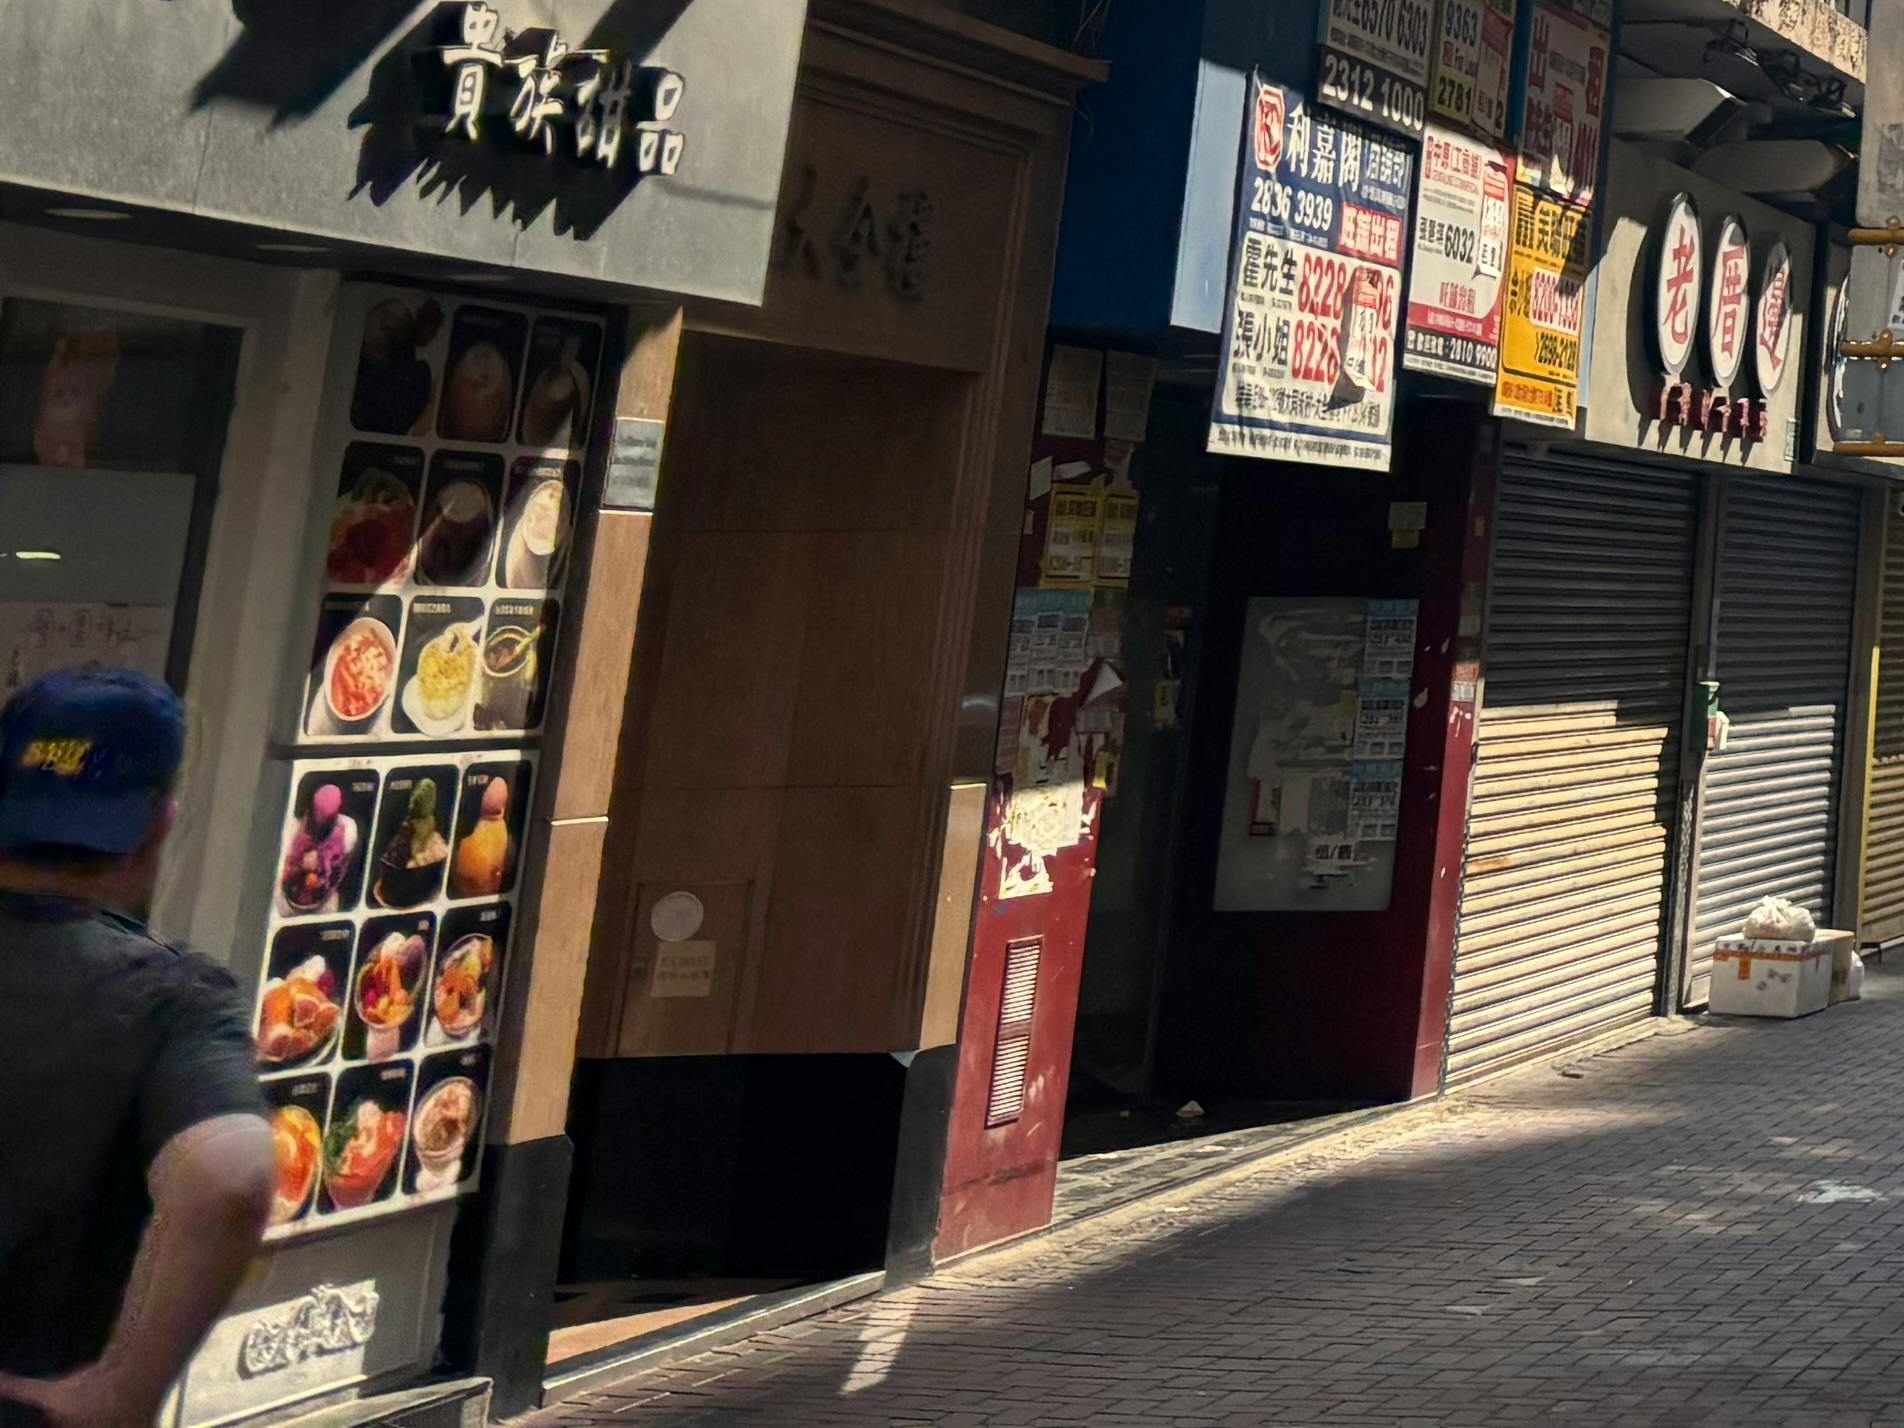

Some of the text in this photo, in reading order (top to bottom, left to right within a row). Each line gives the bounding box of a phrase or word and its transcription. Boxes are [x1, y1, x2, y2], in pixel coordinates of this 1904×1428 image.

[1321, 54, 1425, 131] 2312 1000
[1251, 176, 1290, 223] 2836
[1294, 188, 1334, 233] 3939
